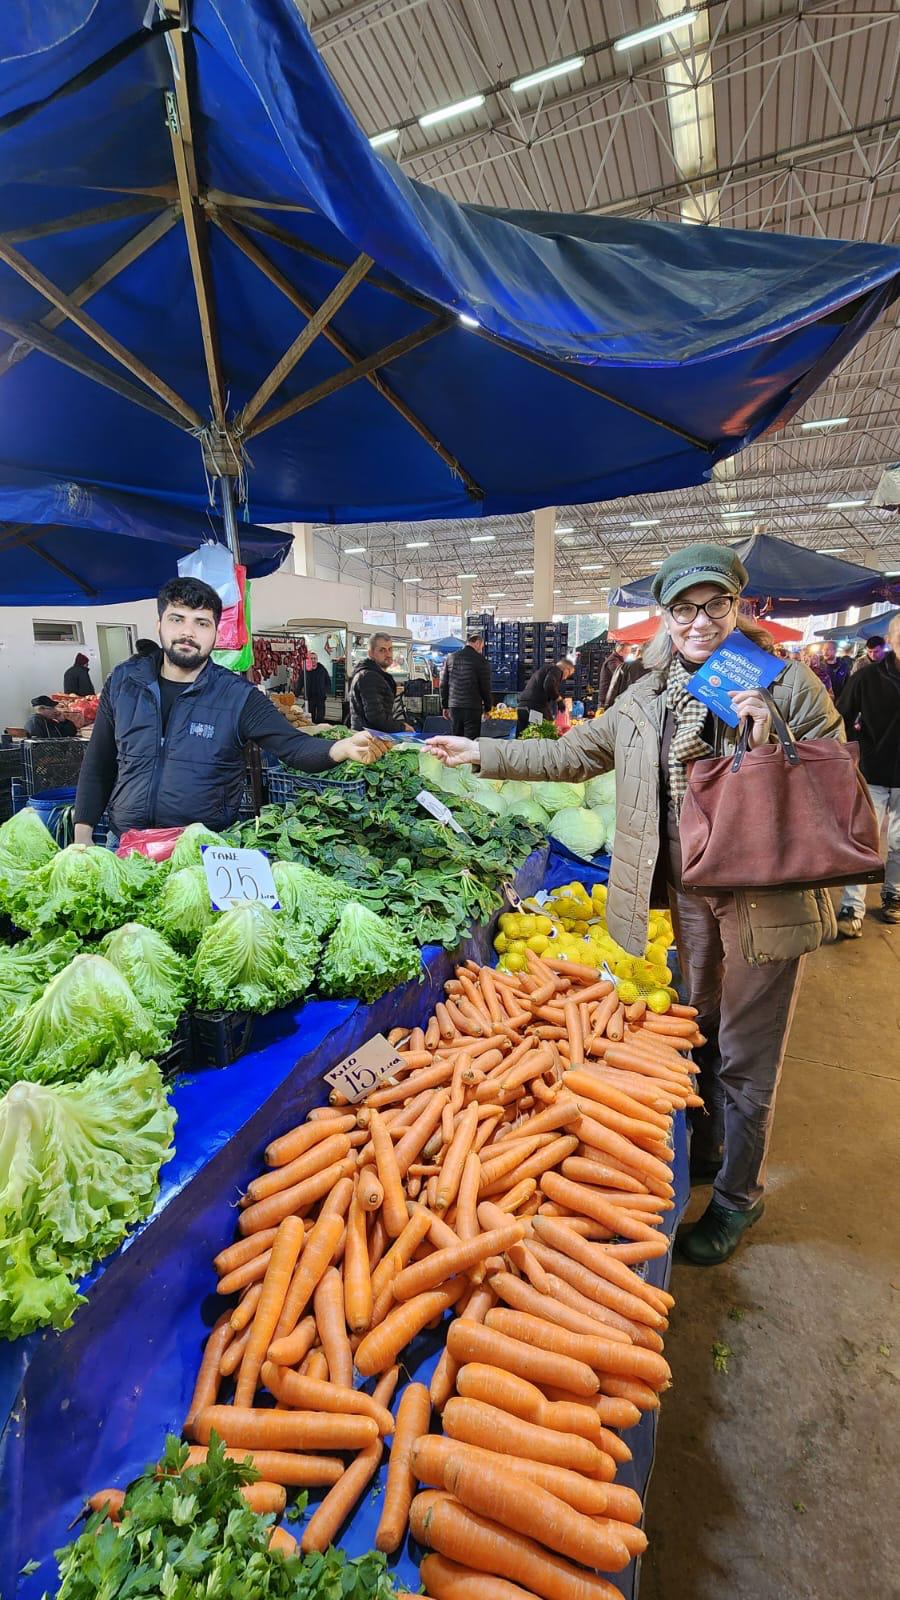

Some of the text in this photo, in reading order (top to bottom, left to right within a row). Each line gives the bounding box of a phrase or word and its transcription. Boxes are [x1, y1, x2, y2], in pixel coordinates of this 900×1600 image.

[721, 650, 761, 675] mahkum
[210, 851, 240, 861] TANE
[216, 866, 259, 901] 25
[344, 1064, 376, 1097] 15
